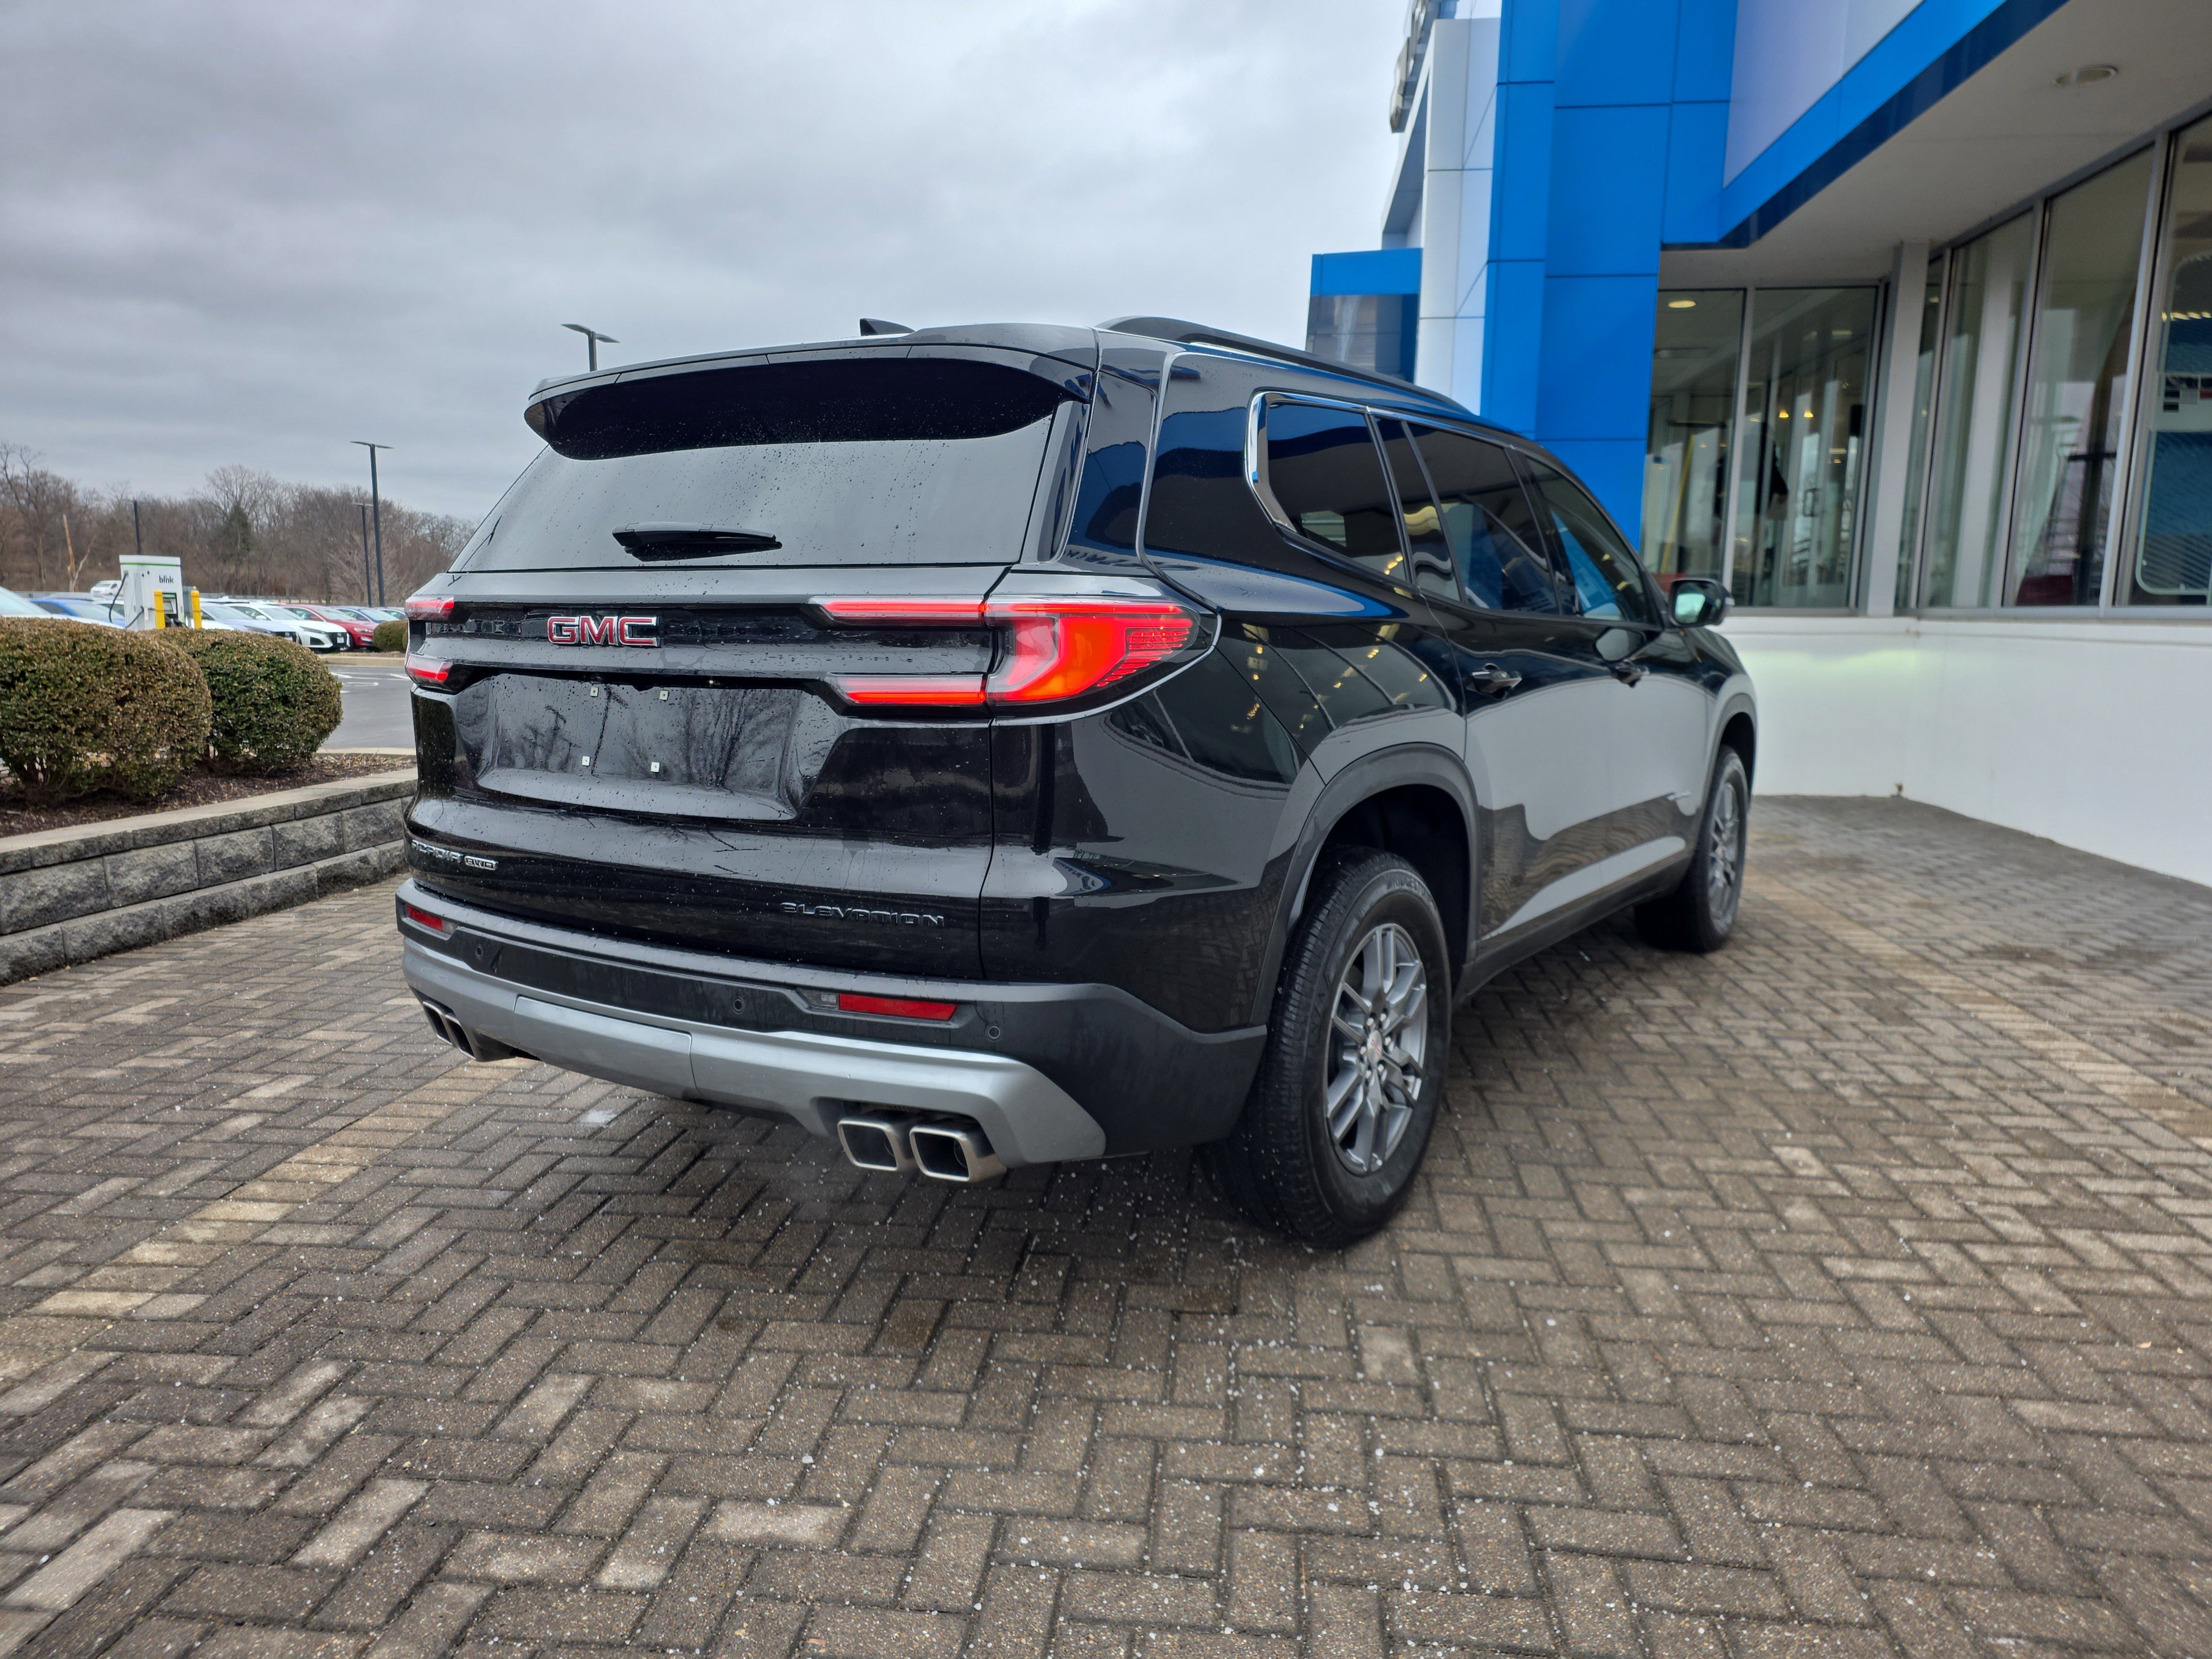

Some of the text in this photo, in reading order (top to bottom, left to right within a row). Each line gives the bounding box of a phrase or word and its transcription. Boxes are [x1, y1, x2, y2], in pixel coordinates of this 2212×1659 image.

[159, 575, 173, 583] blink
[548, 615, 661, 647] GMC
[411, 839, 496, 870] ACADIA AWD
[781, 902, 944, 927] ELEVATION
